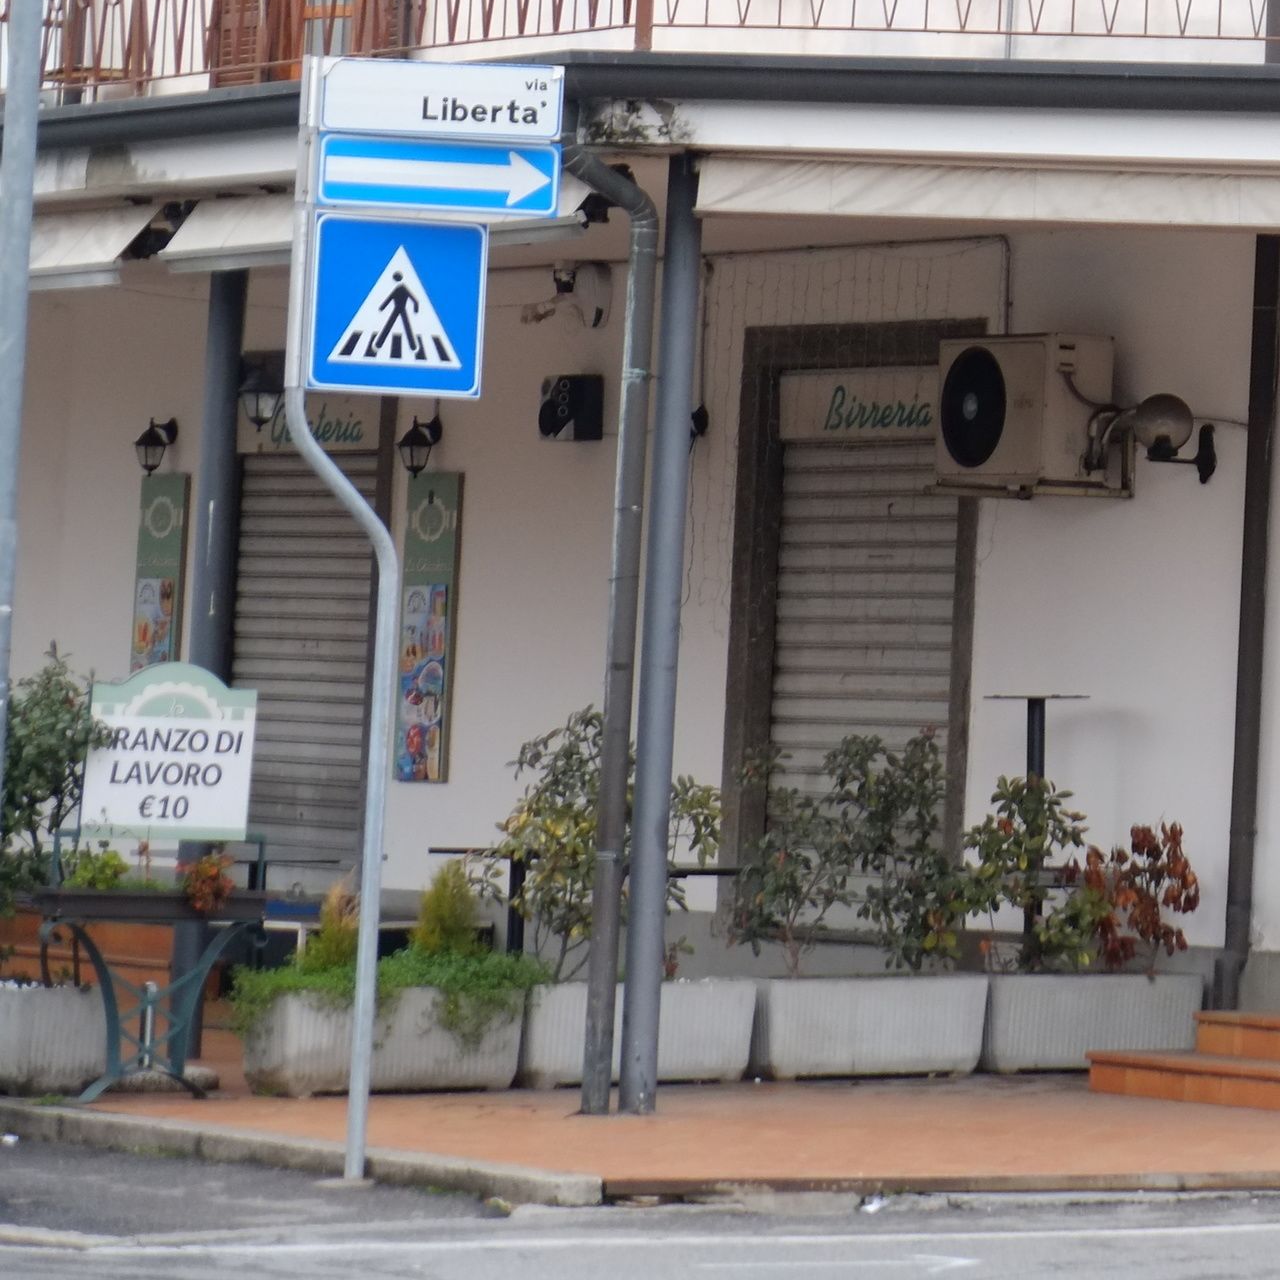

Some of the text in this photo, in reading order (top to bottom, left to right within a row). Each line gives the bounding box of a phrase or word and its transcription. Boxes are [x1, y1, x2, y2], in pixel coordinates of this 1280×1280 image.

[524, 78, 548, 91] via
[824, 385, 933, 430] Birreria
[98, 726, 244, 754] RANZO DI
[109, 760, 222, 787] LAVORO
[138, 794, 189, 819] €10
